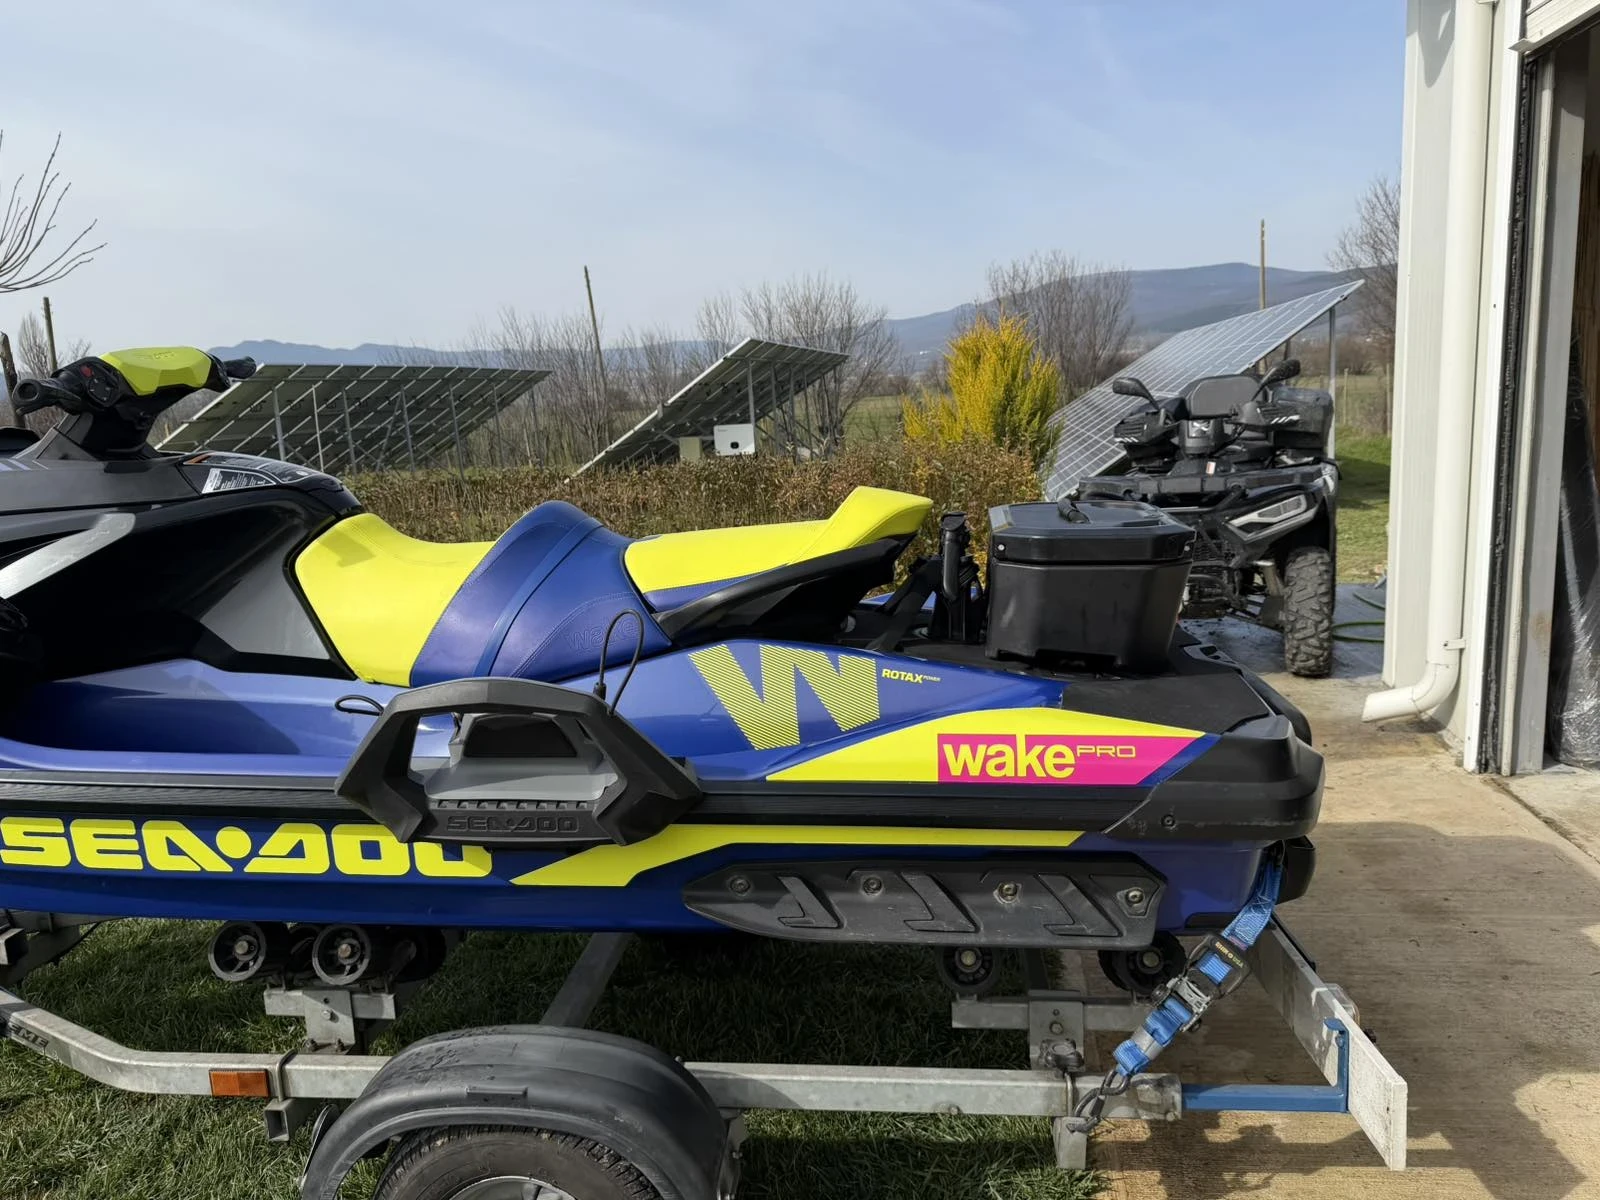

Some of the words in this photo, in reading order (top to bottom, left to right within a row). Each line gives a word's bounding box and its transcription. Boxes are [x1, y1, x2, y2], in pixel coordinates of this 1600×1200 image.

[882, 668, 923, 684] ROTAX
[943, 735, 1076, 779] wake
[1077, 745, 1137, 758] PRO
